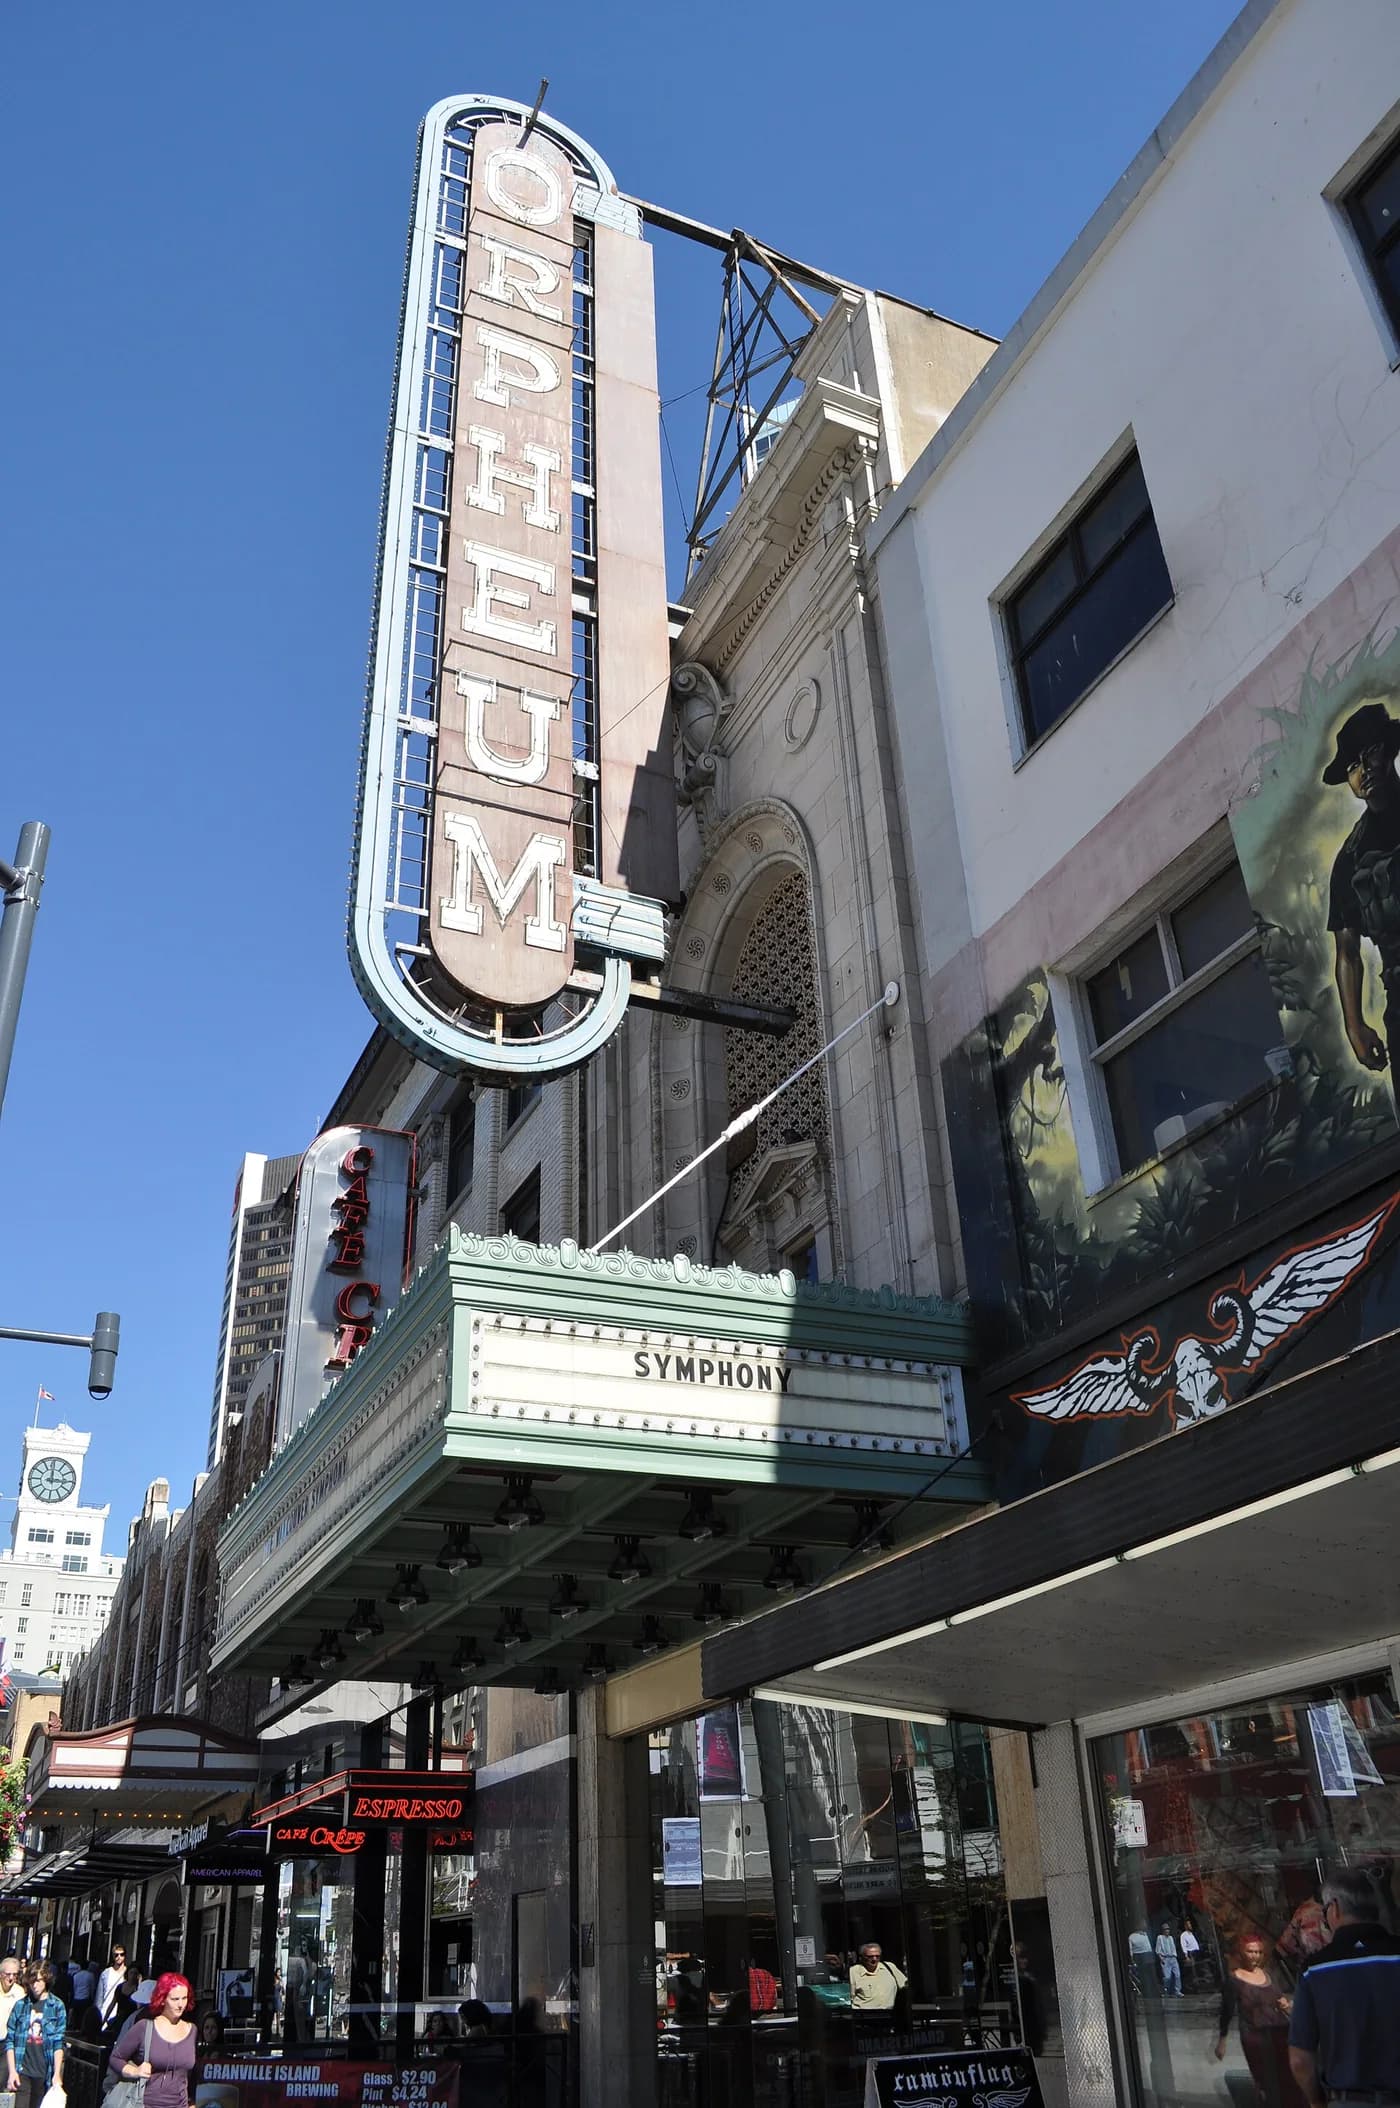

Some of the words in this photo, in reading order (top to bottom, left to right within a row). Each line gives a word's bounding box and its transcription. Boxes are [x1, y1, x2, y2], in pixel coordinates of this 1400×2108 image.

[438, 145, 567, 953] ORPHEUM
[633, 1350, 794, 1394] SYMPHONY
[352, 1797, 463, 1820] ESPRESSO
[276, 1827, 309, 1840] CAFÉ
[190, 1868, 231, 1878] AMERICAN
[231, 1868, 264, 1878] APPAREL
[203, 2063, 272, 2081] GRANVILLE
[275, 2065, 321, 2081] ISLAND
[363, 2072, 393, 2086] Glass
[401, 2070, 437, 2086] $2.90
[286, 2082, 340, 2097] BREWING
[362, 2087, 384, 2101] Pint
[391, 2085, 428, 2101] $4.24
